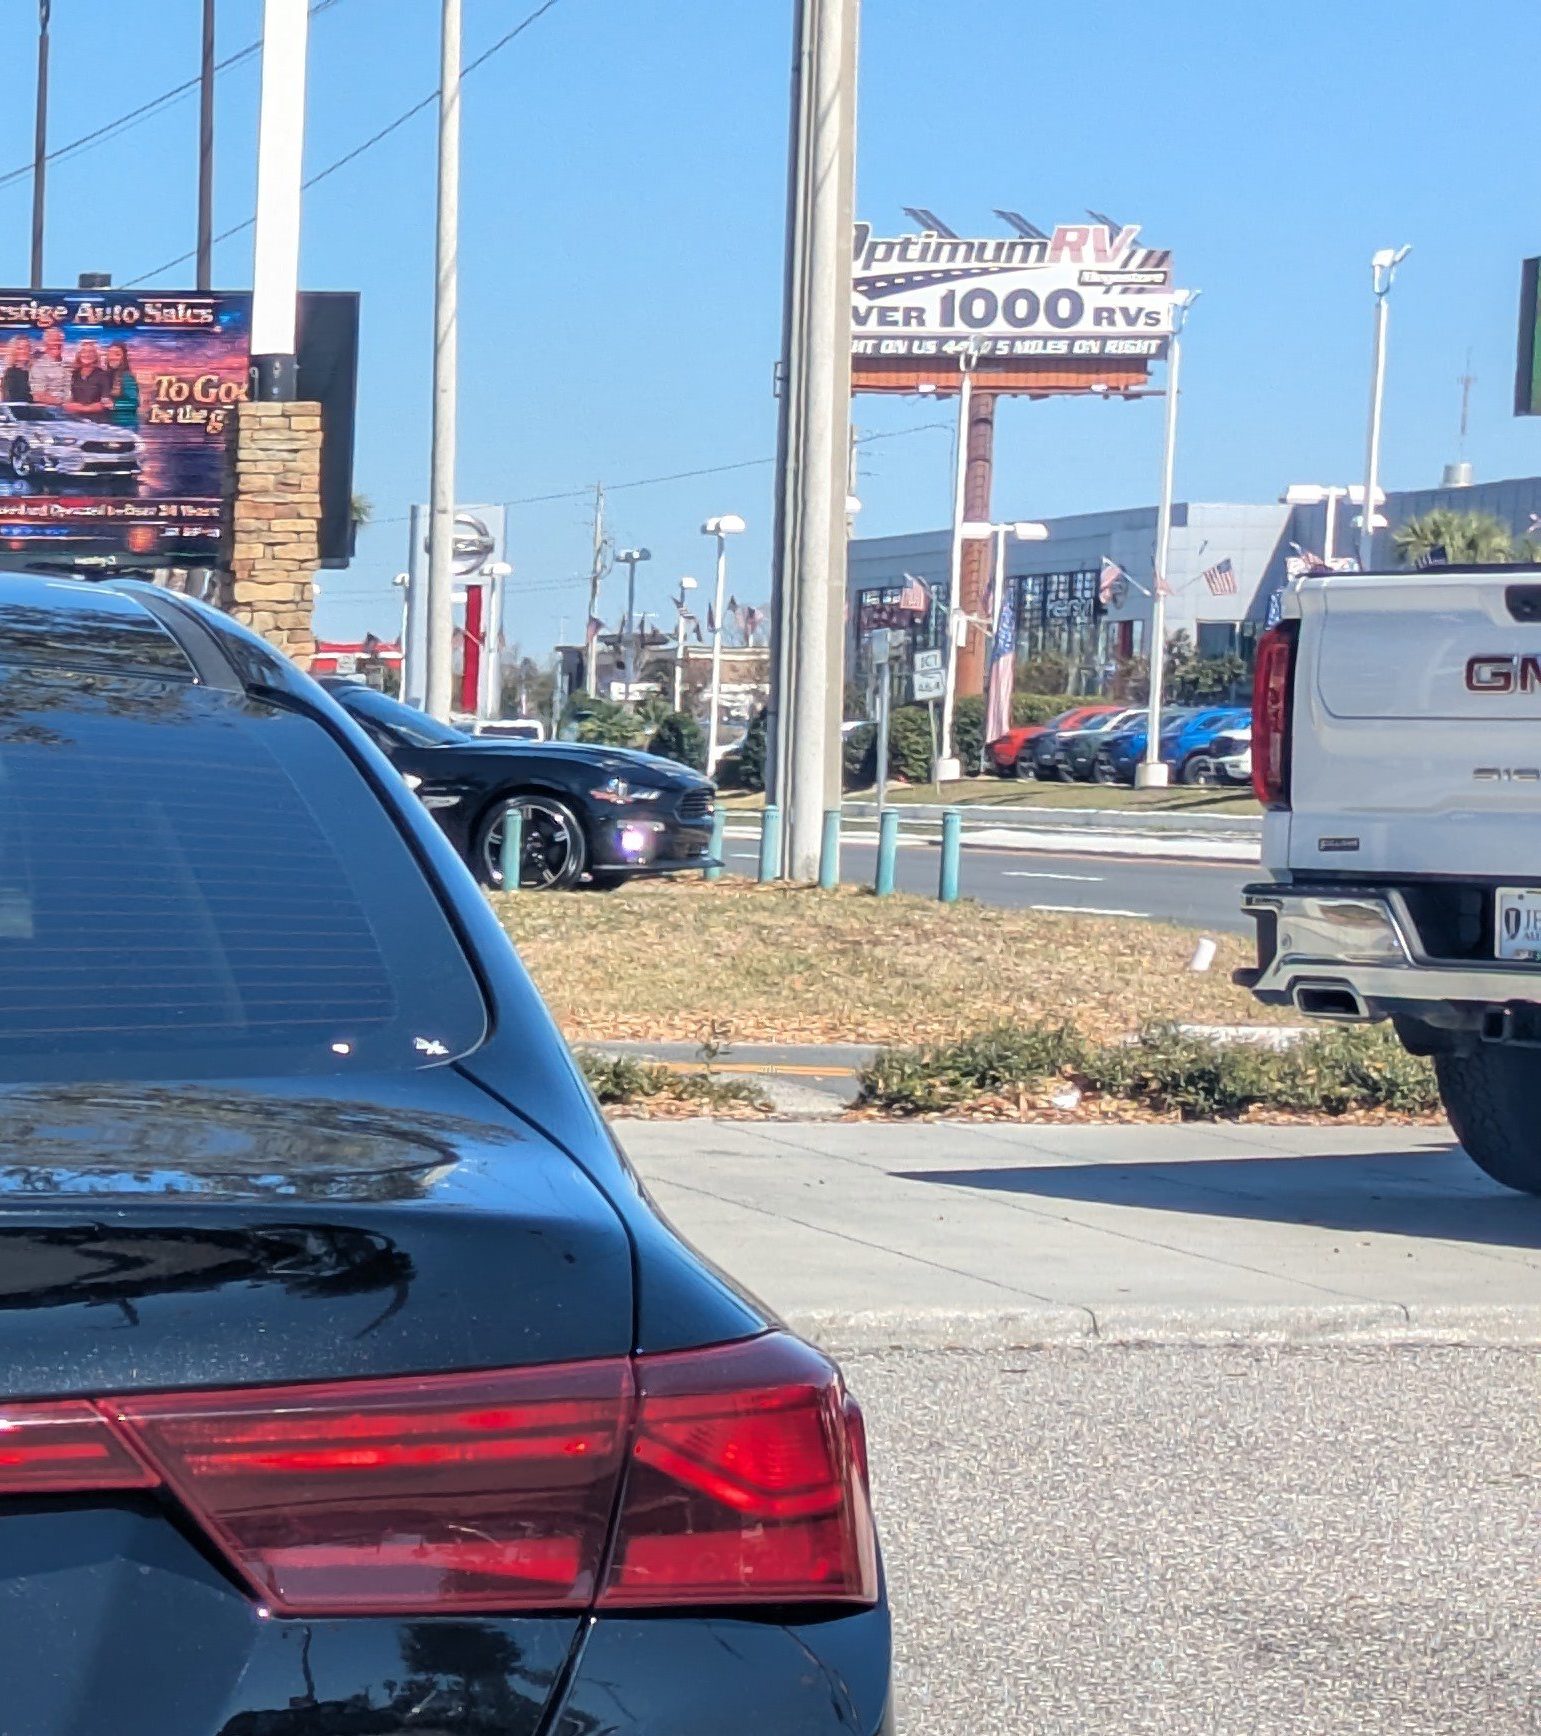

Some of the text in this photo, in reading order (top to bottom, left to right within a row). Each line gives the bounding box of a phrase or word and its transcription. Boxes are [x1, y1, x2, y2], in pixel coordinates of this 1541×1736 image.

[74, 302, 140, 325] Auto
[144, 302, 214, 325] Sales
[852, 306, 926, 327] VER
[938, 288, 1085, 329] 1000
[155, 375, 189, 402] To
